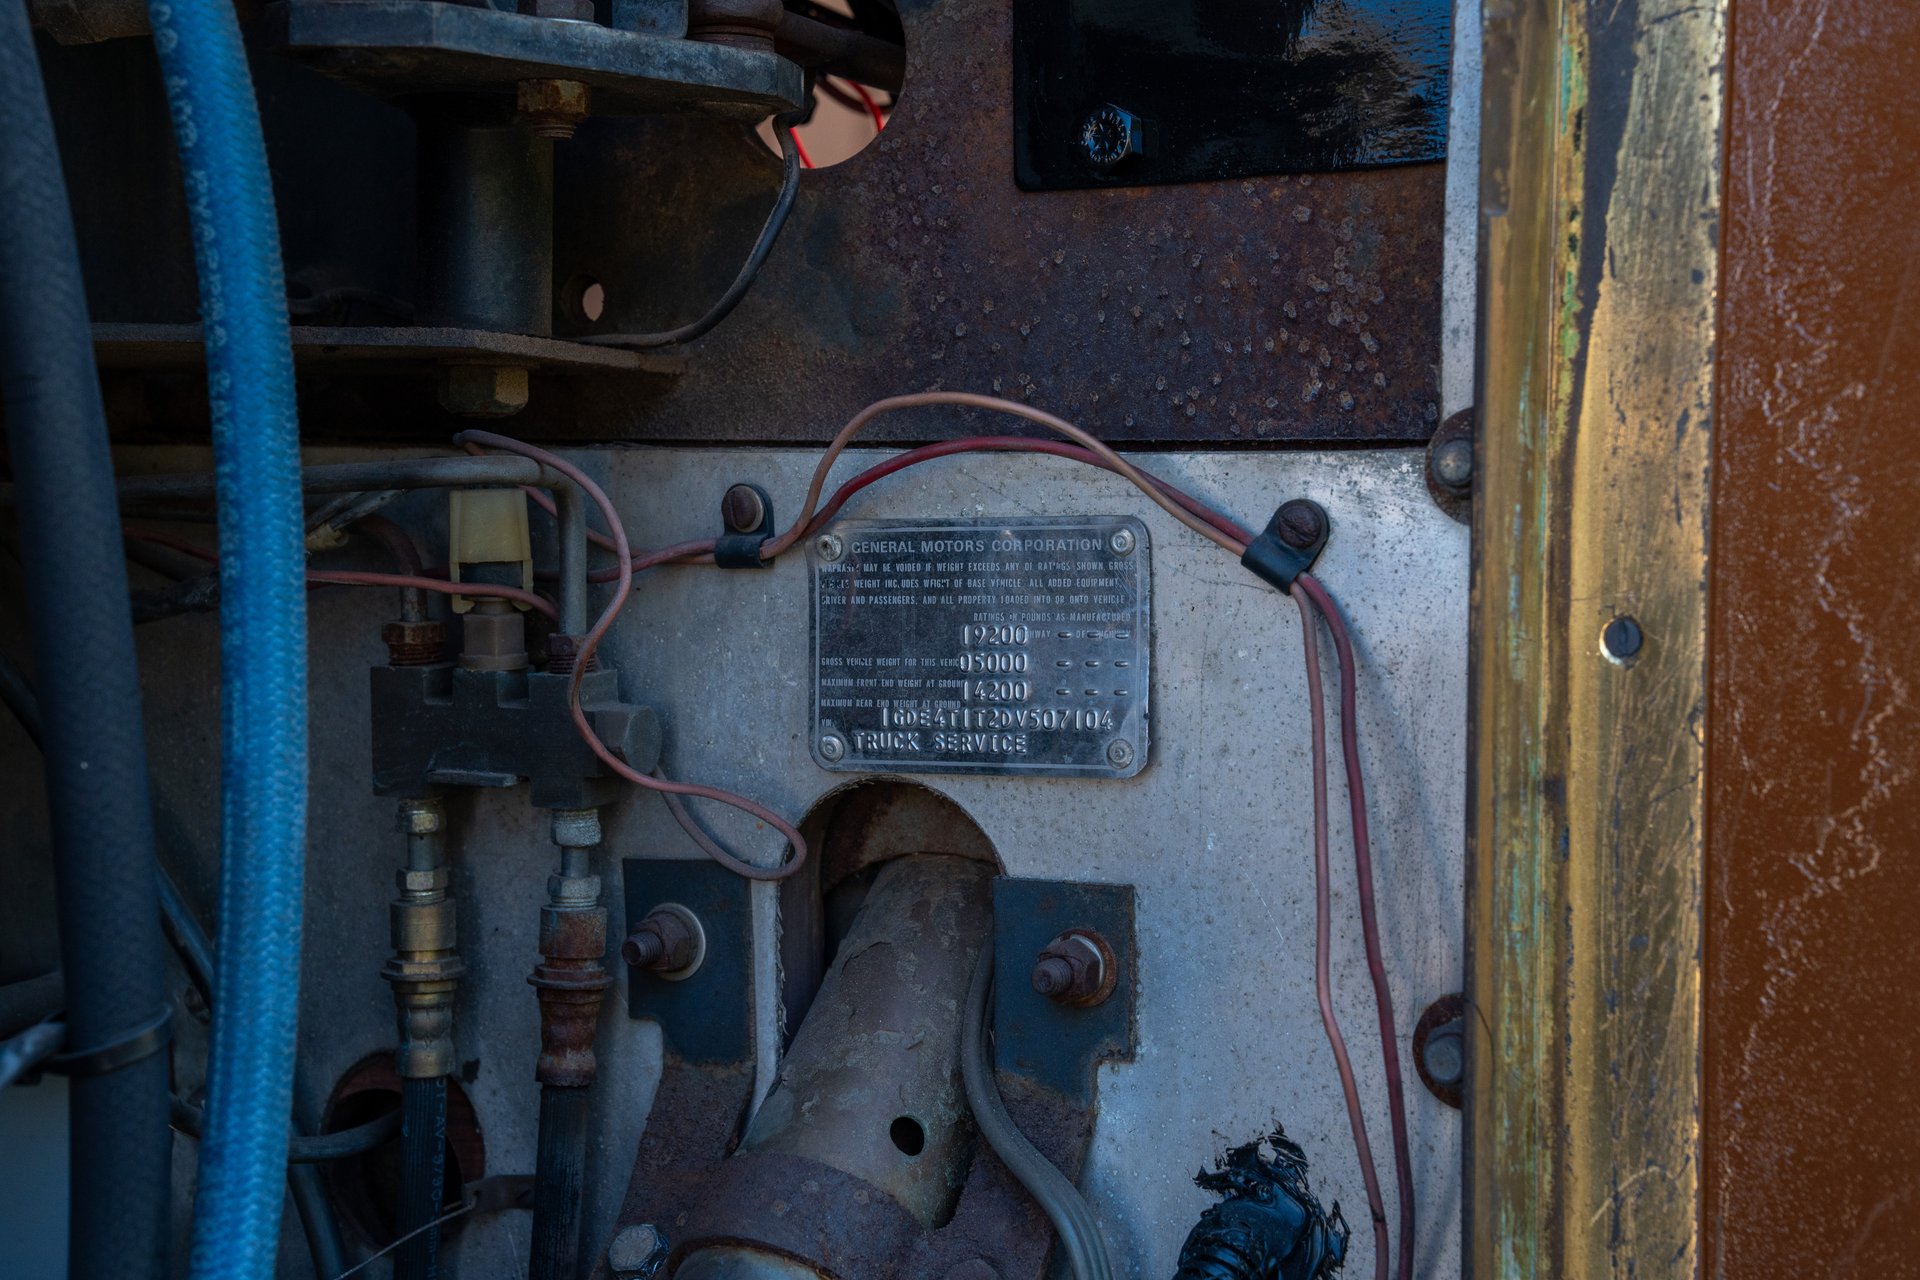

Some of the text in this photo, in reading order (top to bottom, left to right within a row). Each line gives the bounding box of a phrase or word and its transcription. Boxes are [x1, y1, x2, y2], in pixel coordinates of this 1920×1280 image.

[851, 539, 1102, 554] GENERAL MOTORS CORPORATION
[863, 562, 878, 572] MAY
[895, 562, 921, 572] VOIDED
[925, 562, 932, 572] IF
[936, 562, 964, 572] WEIGHT
[968, 562, 1000, 572] EXCEEDS
[1005, 561, 1020, 571] ANY
[1108, 561, 1134, 571] GROSS
[854, 579, 881, 589] WEIGHT
[954, 579, 963, 589] OF
[967, 579, 986, 589] BASE
[1029, 578, 1044, 588] ALL
[1047, 578, 1072, 588] ADDED
[850, 595, 866, 605] AND
[922, 595, 937, 605] AND
[940, 595, 954, 605] ALL
[957, 595, 996, 605] PROPERTY
[1033, 595, 1051, 605] INTO
[1055, 595, 1065, 605] OR
[1069, 595, 1089, 605] ONTO
[1093, 595, 1126, 605] VEHICLE
[973, 612, 1005, 622] RATINGS
[1021, 612, 1051, 622] POUNDS
[962, 624, 1028, 646] 19200
[821, 657, 843, 667] GROSS
[846, 657, 873, 667] VEHICLE
[876, 657, 901, 667] WEIGHT
[904, 657, 917, 667] FOR
[921, 657, 936, 667] THIS
[959, 652, 1028, 674] 05000
[821, 678, 854, 688] MAXIMUM
[857, 678, 878, 688] FRONT
[881, 678, 894, 688] END
[897, 678, 922, 688] WEIGHT
[925, 678, 935, 688] AT
[962, 680, 1028, 702] 14200
[821, 699, 853, 708] MAXIMUM
[856, 699, 873, 708] REAR
[876, 699, 890, 708] END
[893, 699, 919, 708] WEIGHT
[921, 699, 930, 708] AT
[853, 730, 1028, 754] TRUCK SERVICE
